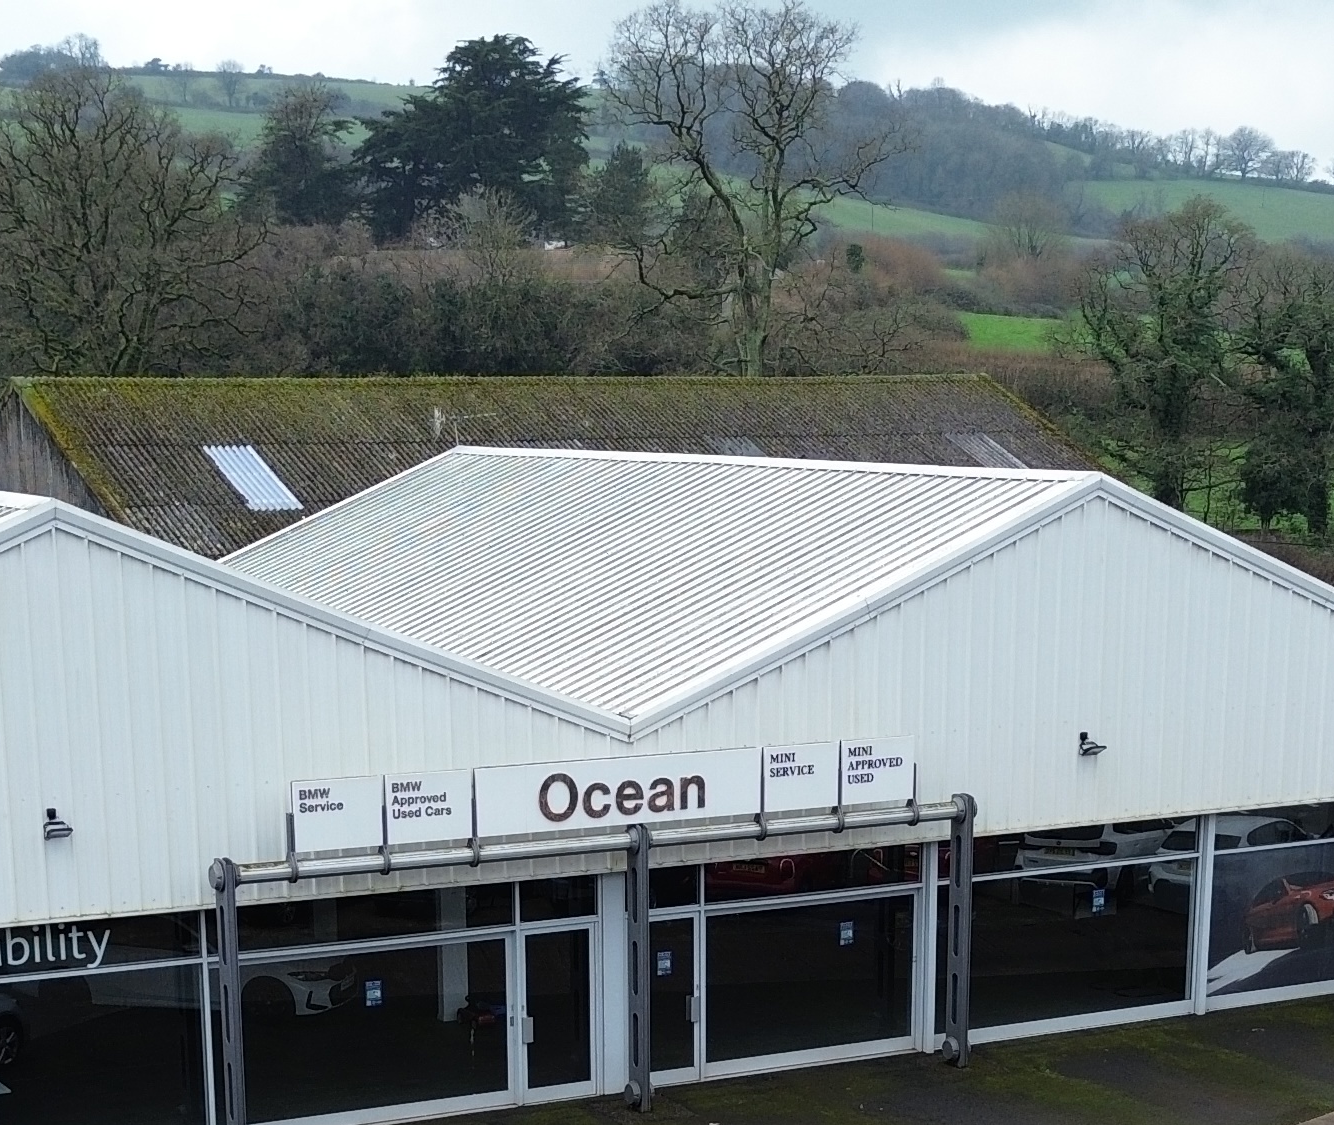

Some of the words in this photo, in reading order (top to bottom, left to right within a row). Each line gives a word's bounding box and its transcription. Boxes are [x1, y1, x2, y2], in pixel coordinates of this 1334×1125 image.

[770, 752, 796, 764] MINI
[847, 745, 873, 757] MINI
[769, 764, 814, 778] SERVICE
[847, 757, 903, 771] APPROVED
[847, 772, 874, 784] USED
[298, 787, 330, 801] BMW
[391, 780, 422, 794] BMW
[391, 792, 447, 807] Approved
[539, 773, 706, 822] Ocean
[299, 801, 344, 814] Service
[392, 807, 422, 819] Used
[425, 806, 452, 817] Cars
